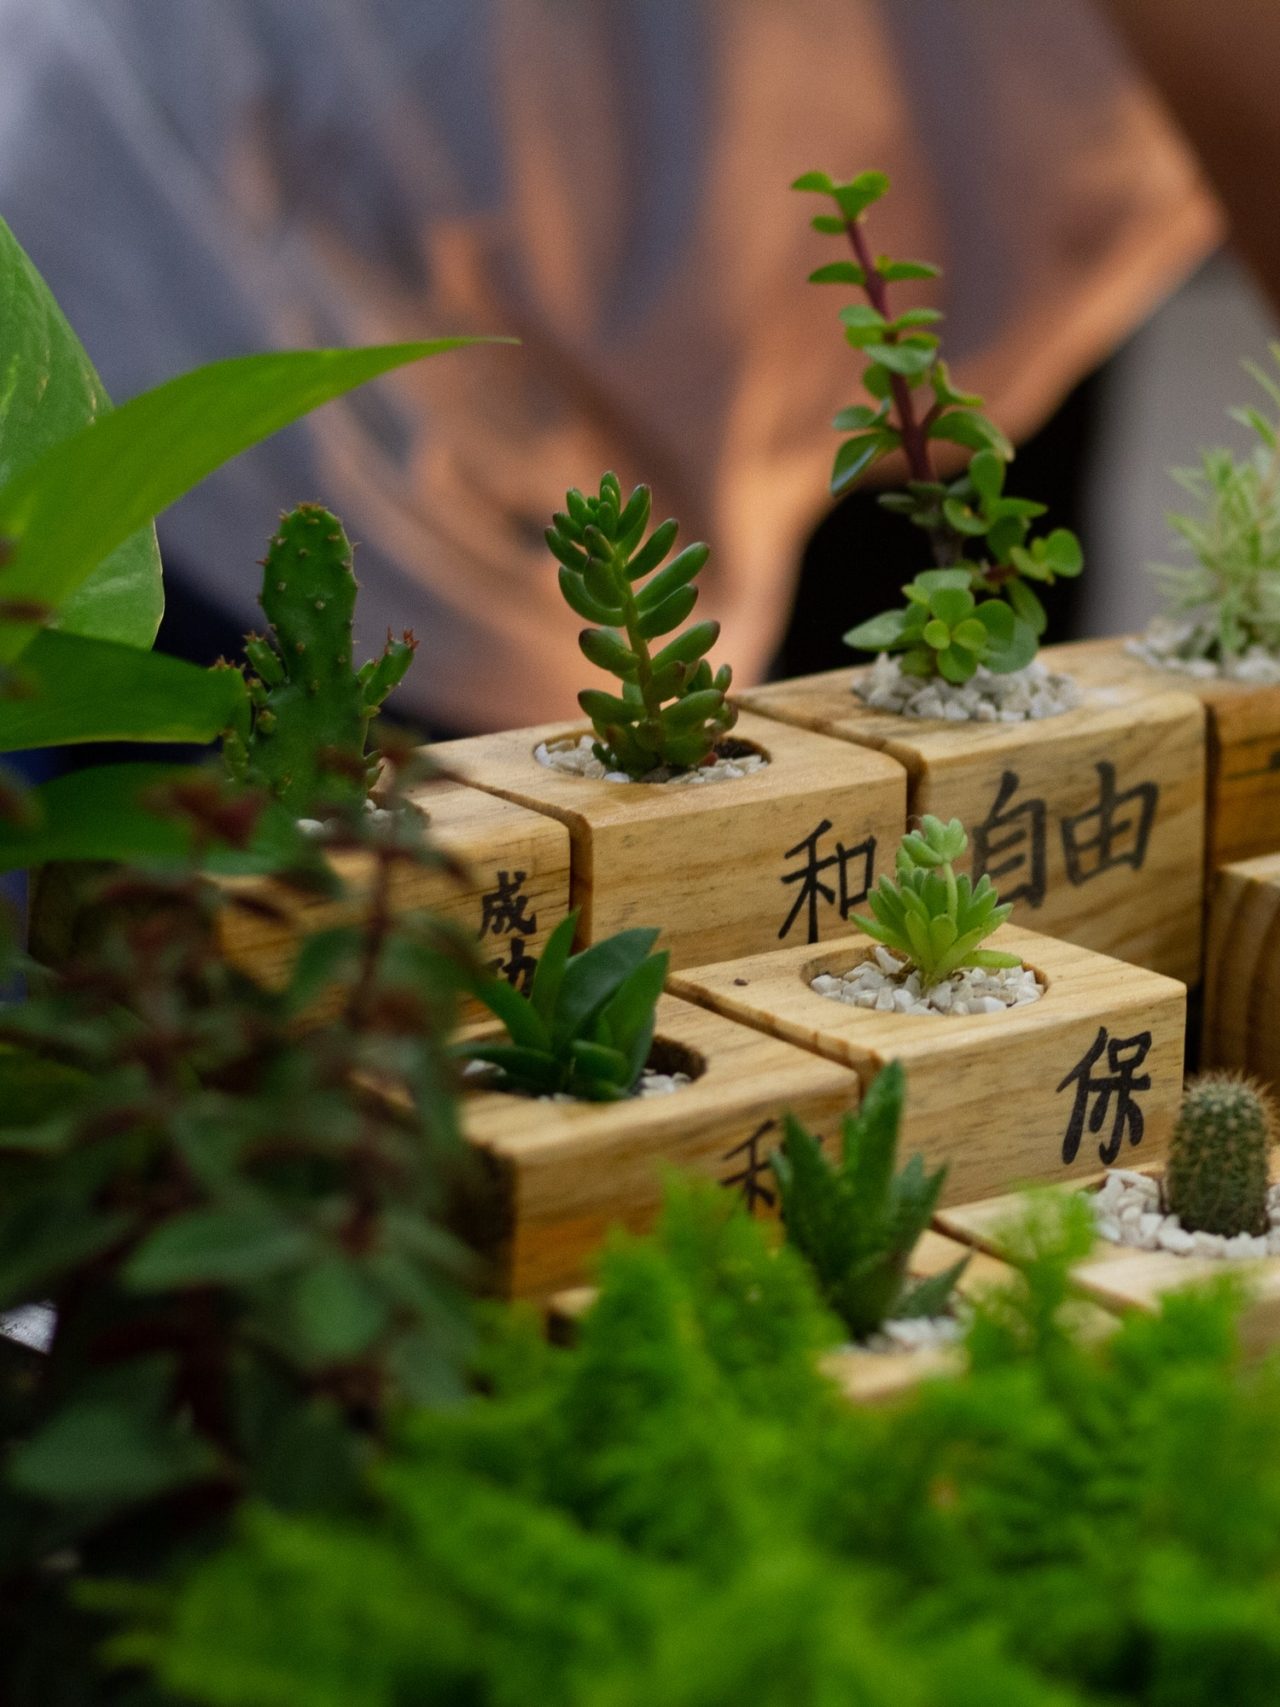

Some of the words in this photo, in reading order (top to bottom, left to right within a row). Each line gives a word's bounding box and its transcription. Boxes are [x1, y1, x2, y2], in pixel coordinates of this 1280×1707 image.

[778, 819, 877, 944] 和
[970, 760, 1159, 908] 自由
[1056, 1026, 1152, 1165] 保
